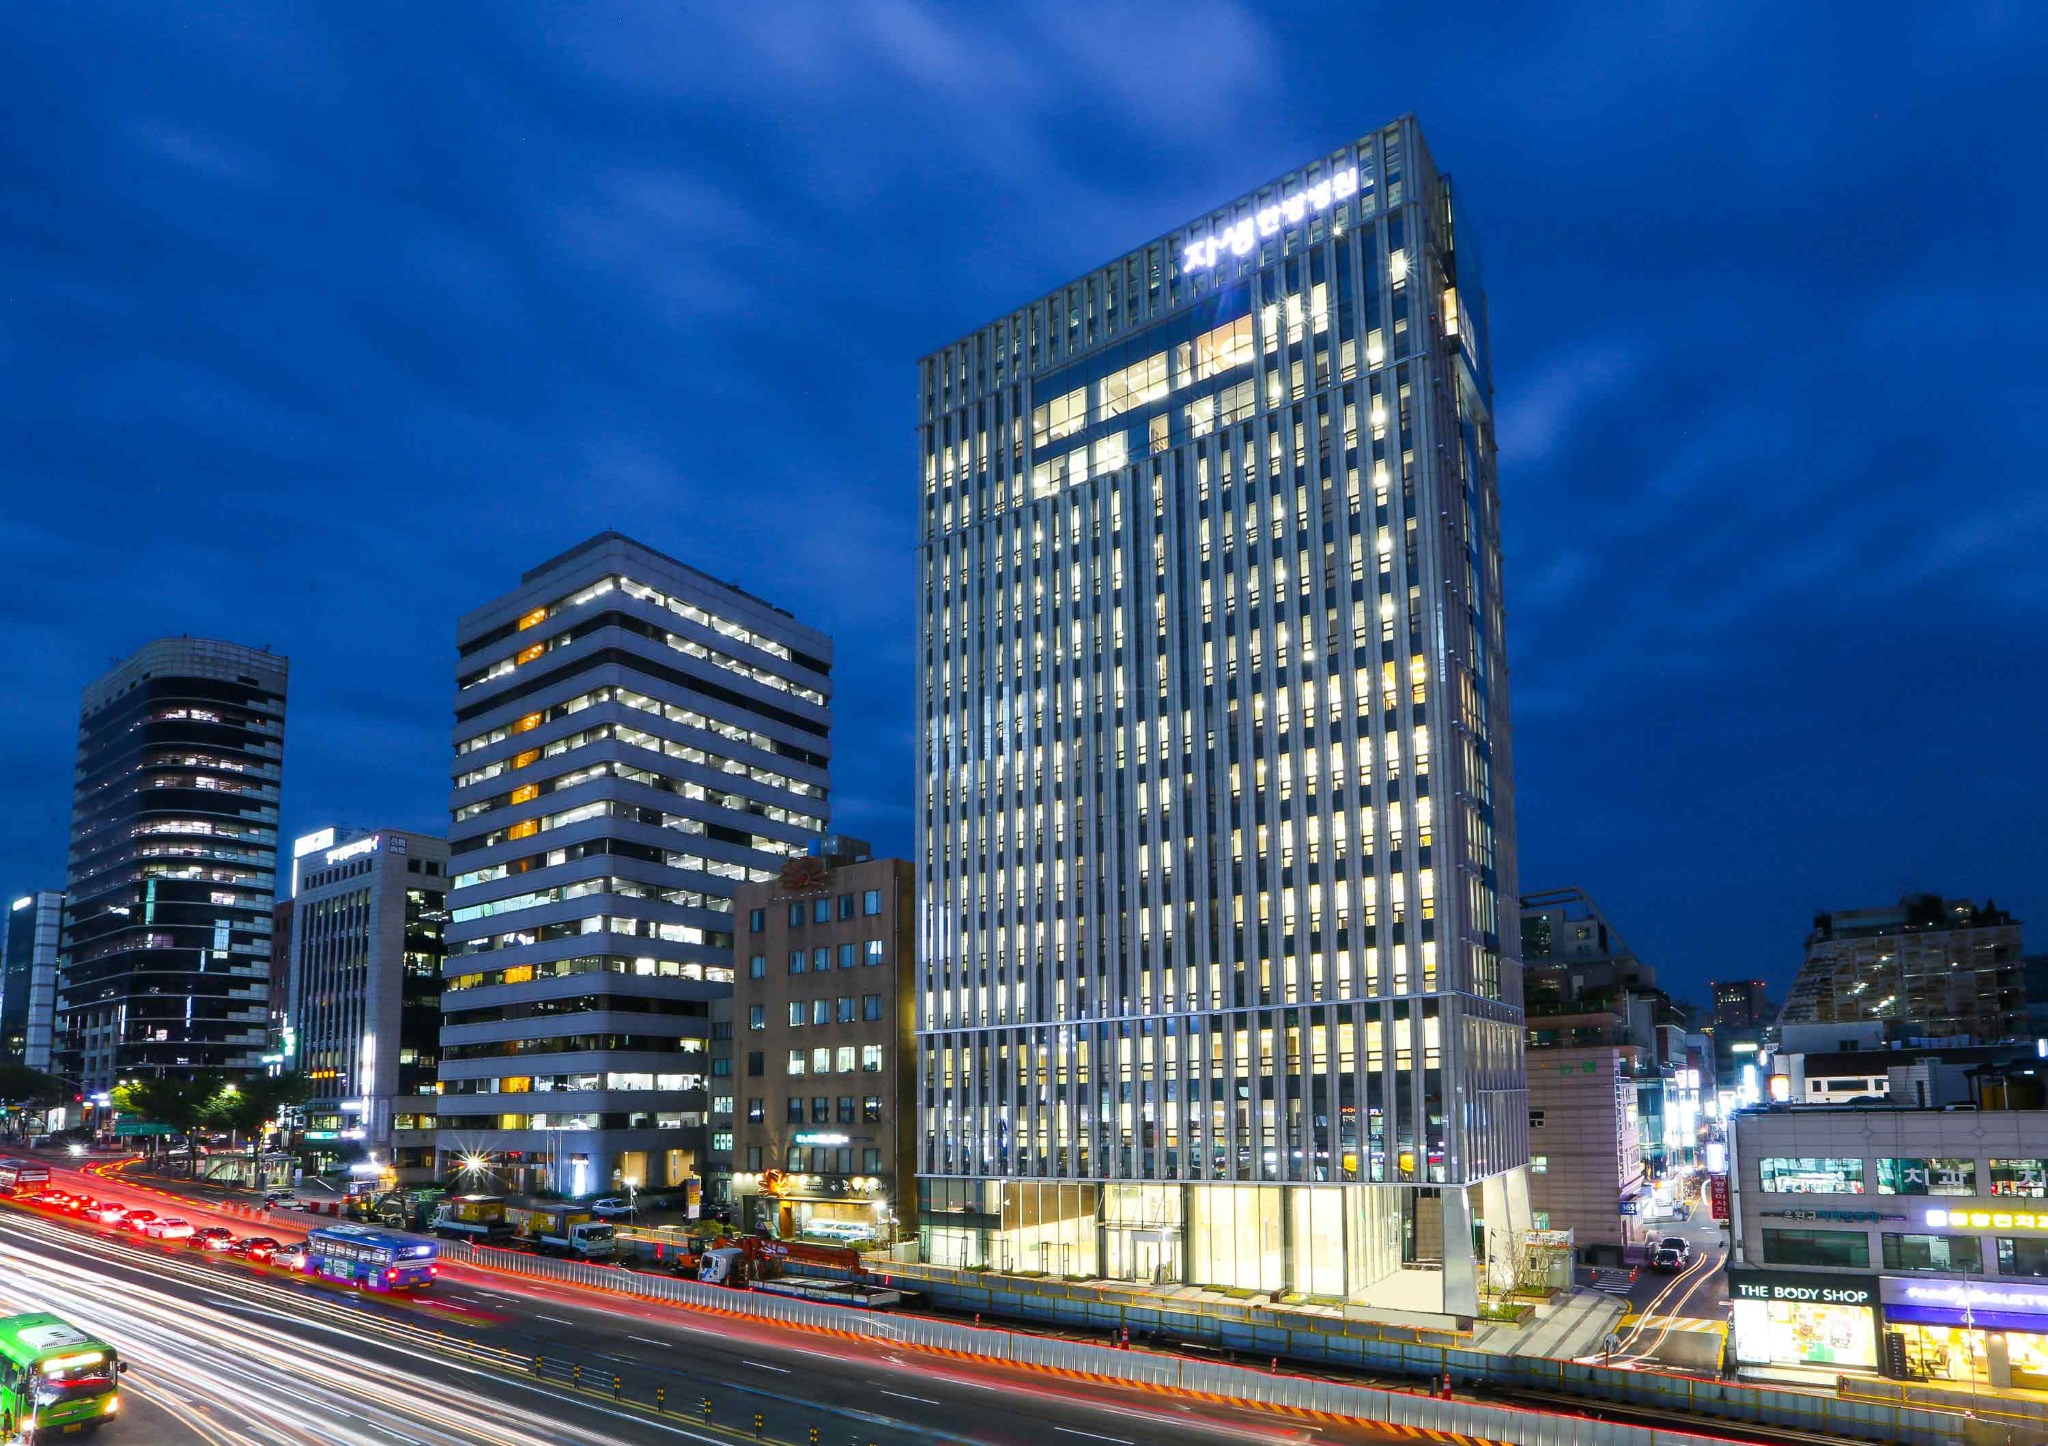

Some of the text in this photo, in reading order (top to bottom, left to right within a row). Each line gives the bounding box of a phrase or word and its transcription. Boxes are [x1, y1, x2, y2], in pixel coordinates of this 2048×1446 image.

[1904, 1168, 1966, 1186] 치과
[1739, 1284, 1868, 1302] THE BODY SHOP
